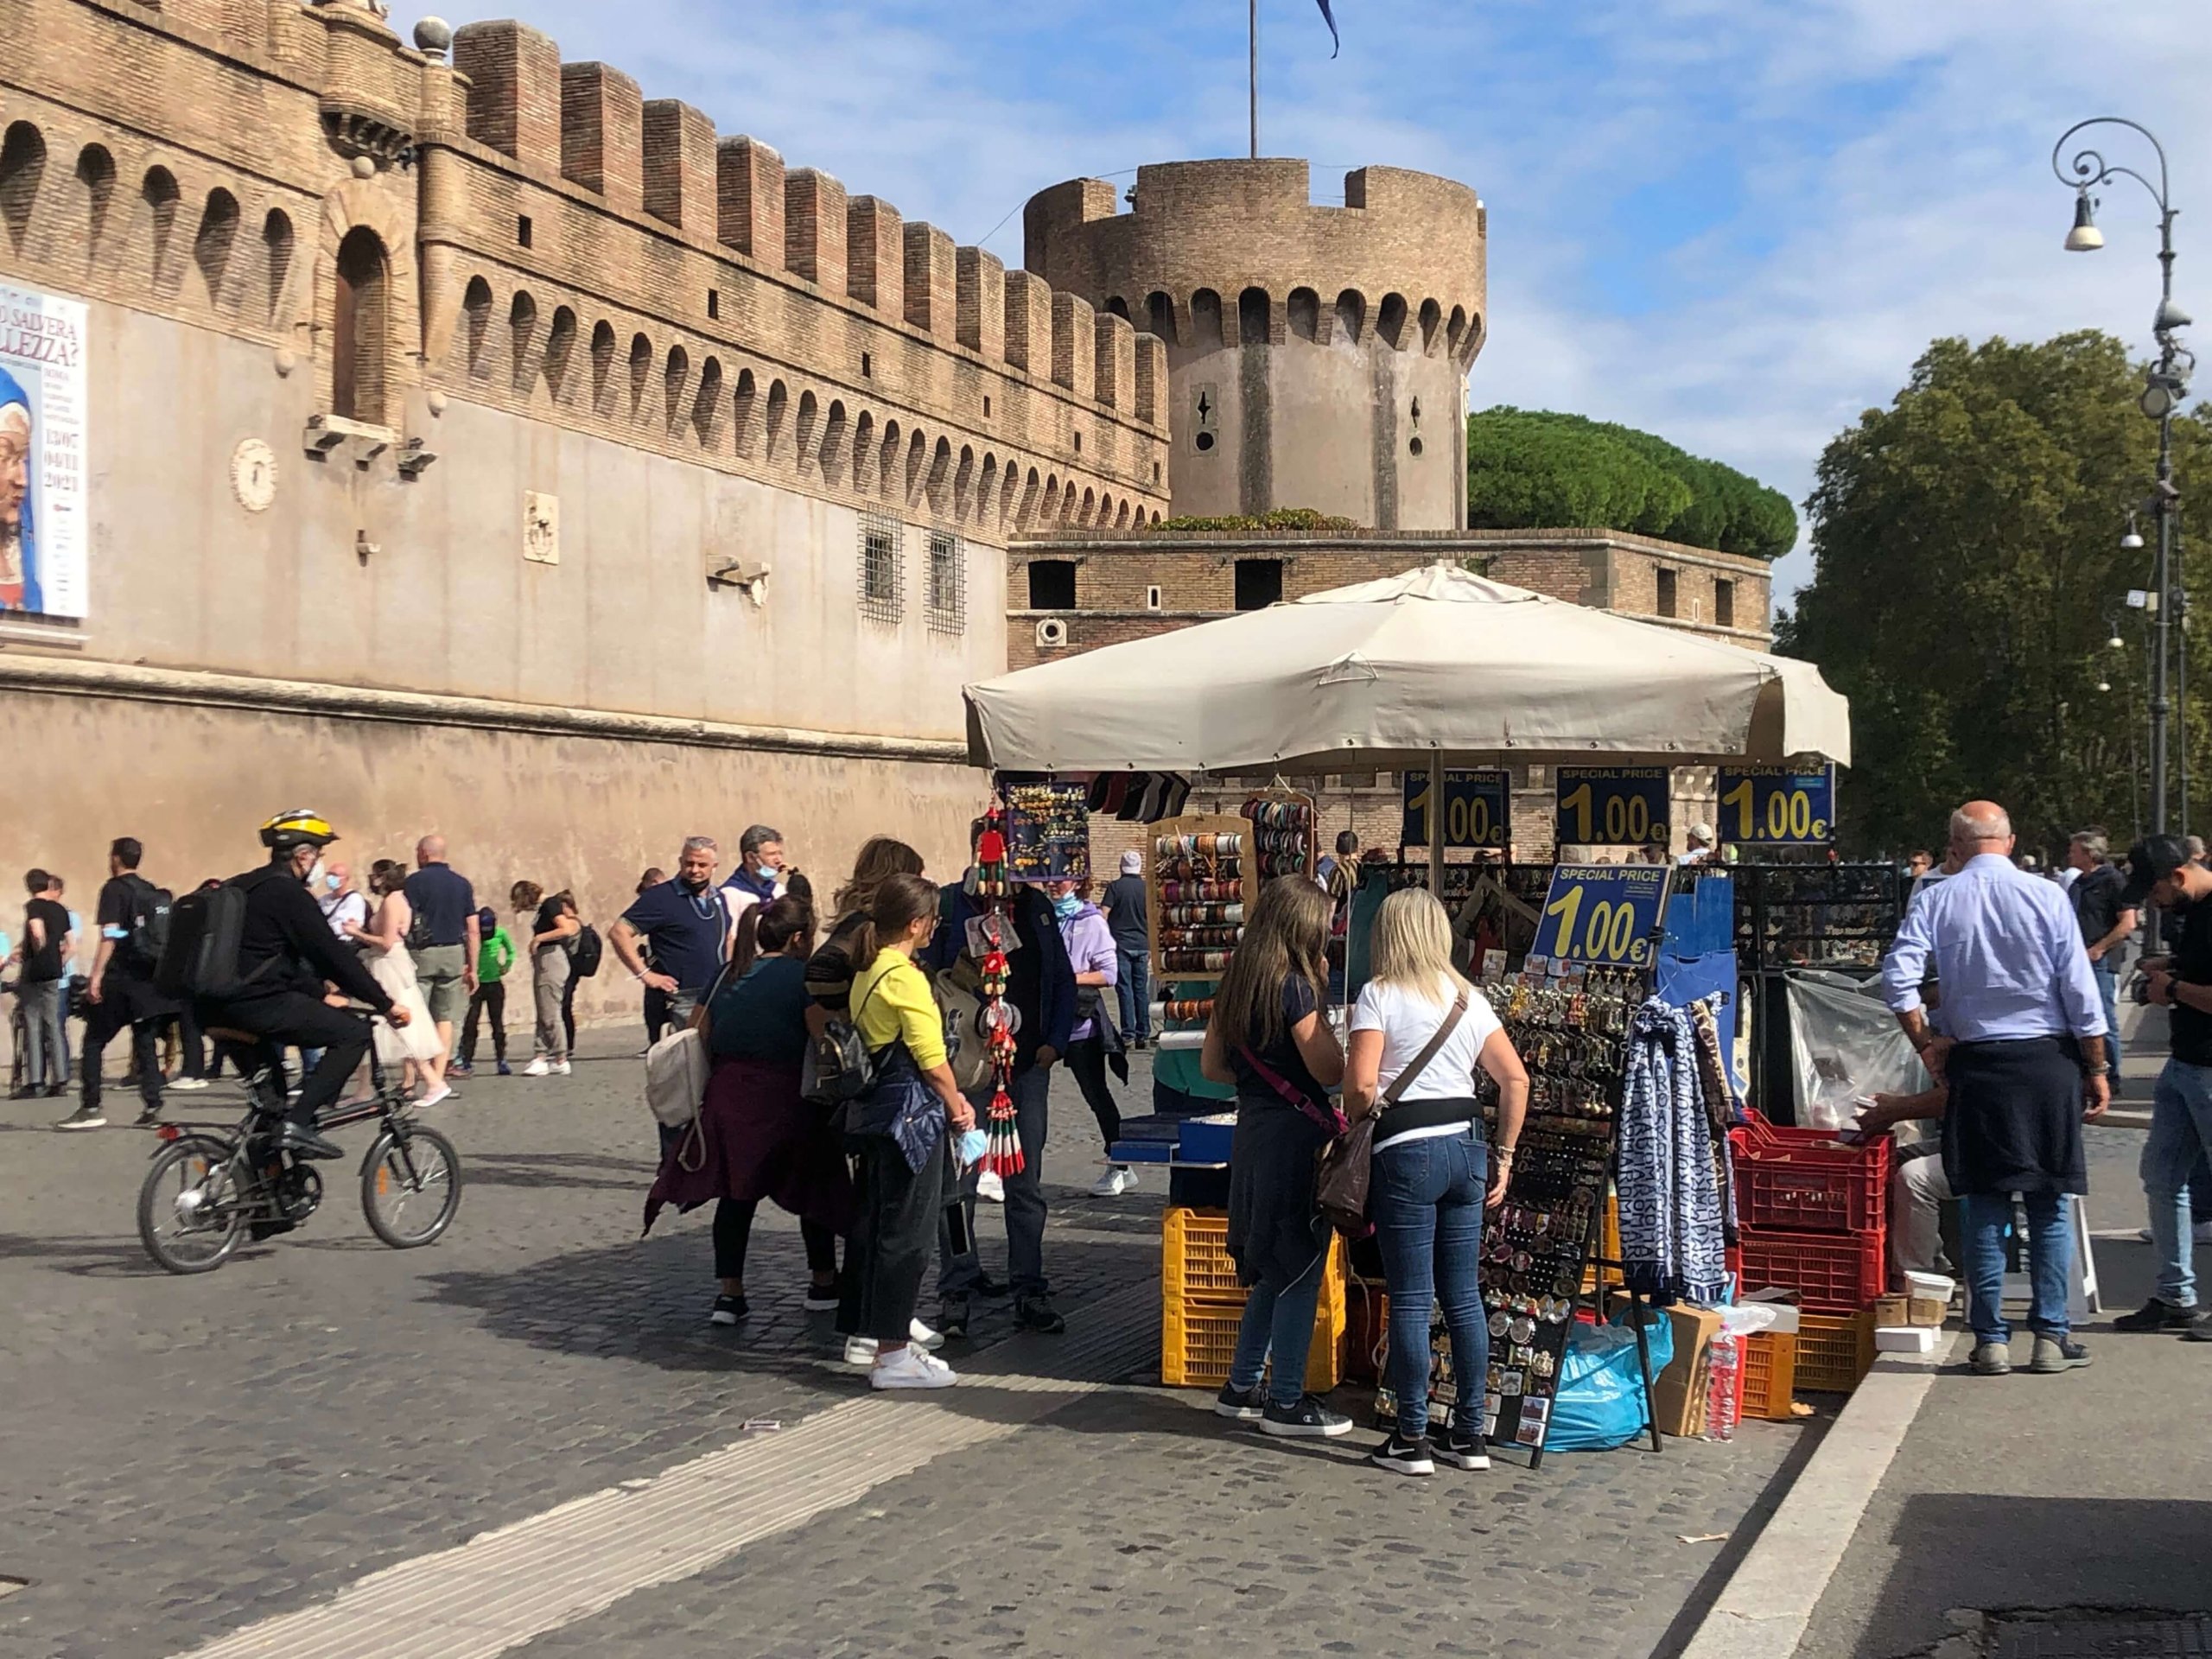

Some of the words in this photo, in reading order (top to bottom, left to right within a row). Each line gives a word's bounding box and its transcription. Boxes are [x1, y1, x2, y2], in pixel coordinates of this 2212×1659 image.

[44, 472, 79, 493] 2021
[1561, 769, 1618, 779] SPECIAL
[1622, 768, 1663, 779] PRICE
[1724, 766, 1783, 777] SPECIAL
[1560, 868, 1615, 880] SPECIAL
[1618, 869, 1661, 882] PRICE
